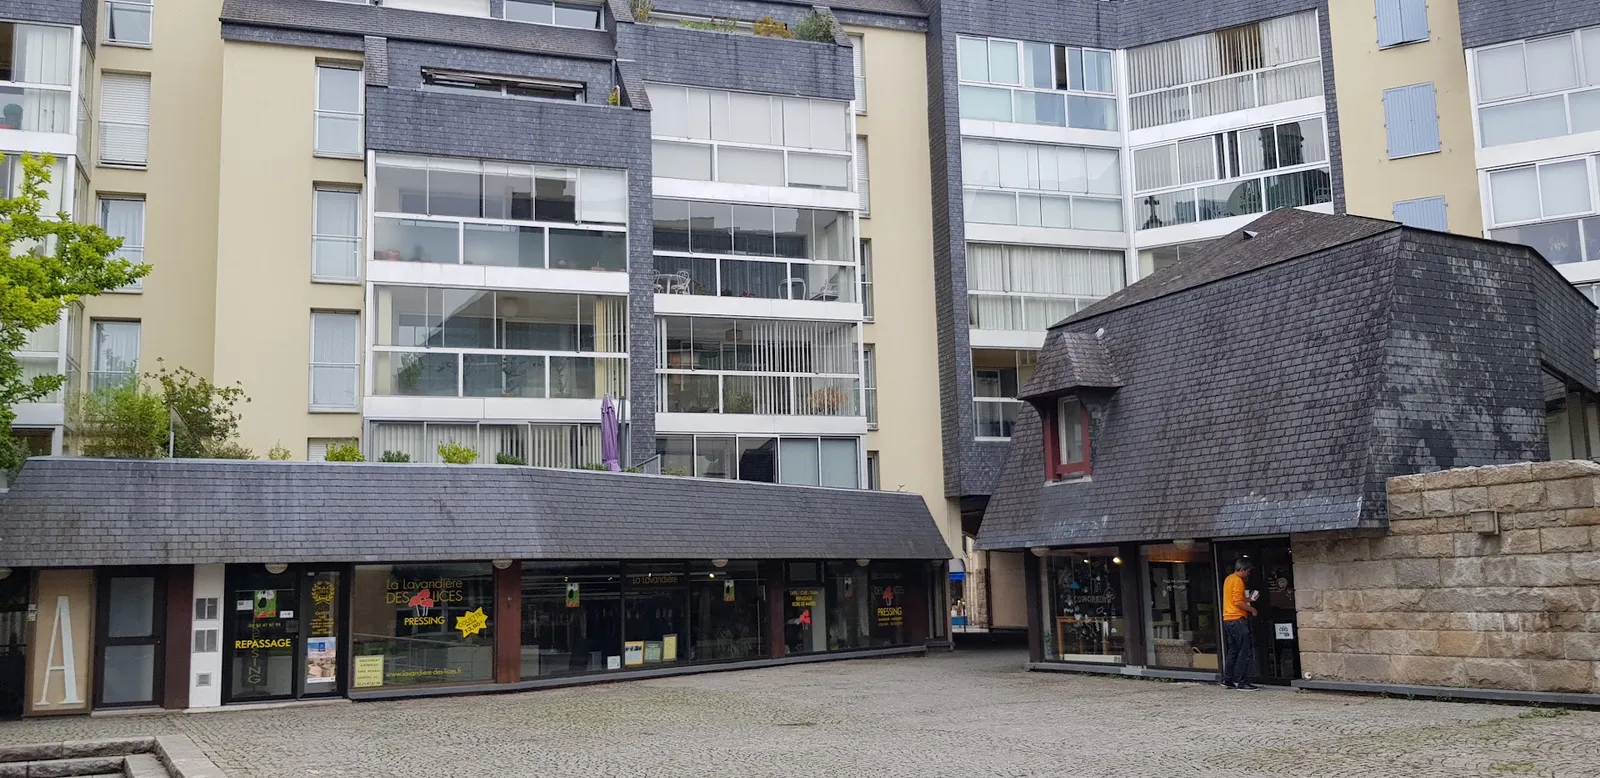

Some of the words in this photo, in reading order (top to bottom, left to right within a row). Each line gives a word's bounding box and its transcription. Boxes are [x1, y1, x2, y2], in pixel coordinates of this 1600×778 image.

[386, 578, 399, 590] La
[403, 576, 463, 590] Lavandière
[386, 591, 410, 604] DES
[432, 590, 463, 603] LICES
[878, 607, 903, 617] PRESSING
[404, 617, 446, 626] PRESSING
[458, 612, 483, 628] COUETTE
[235, 638, 292, 649] REPASSAGE
[35, 596, 84, 706] A
